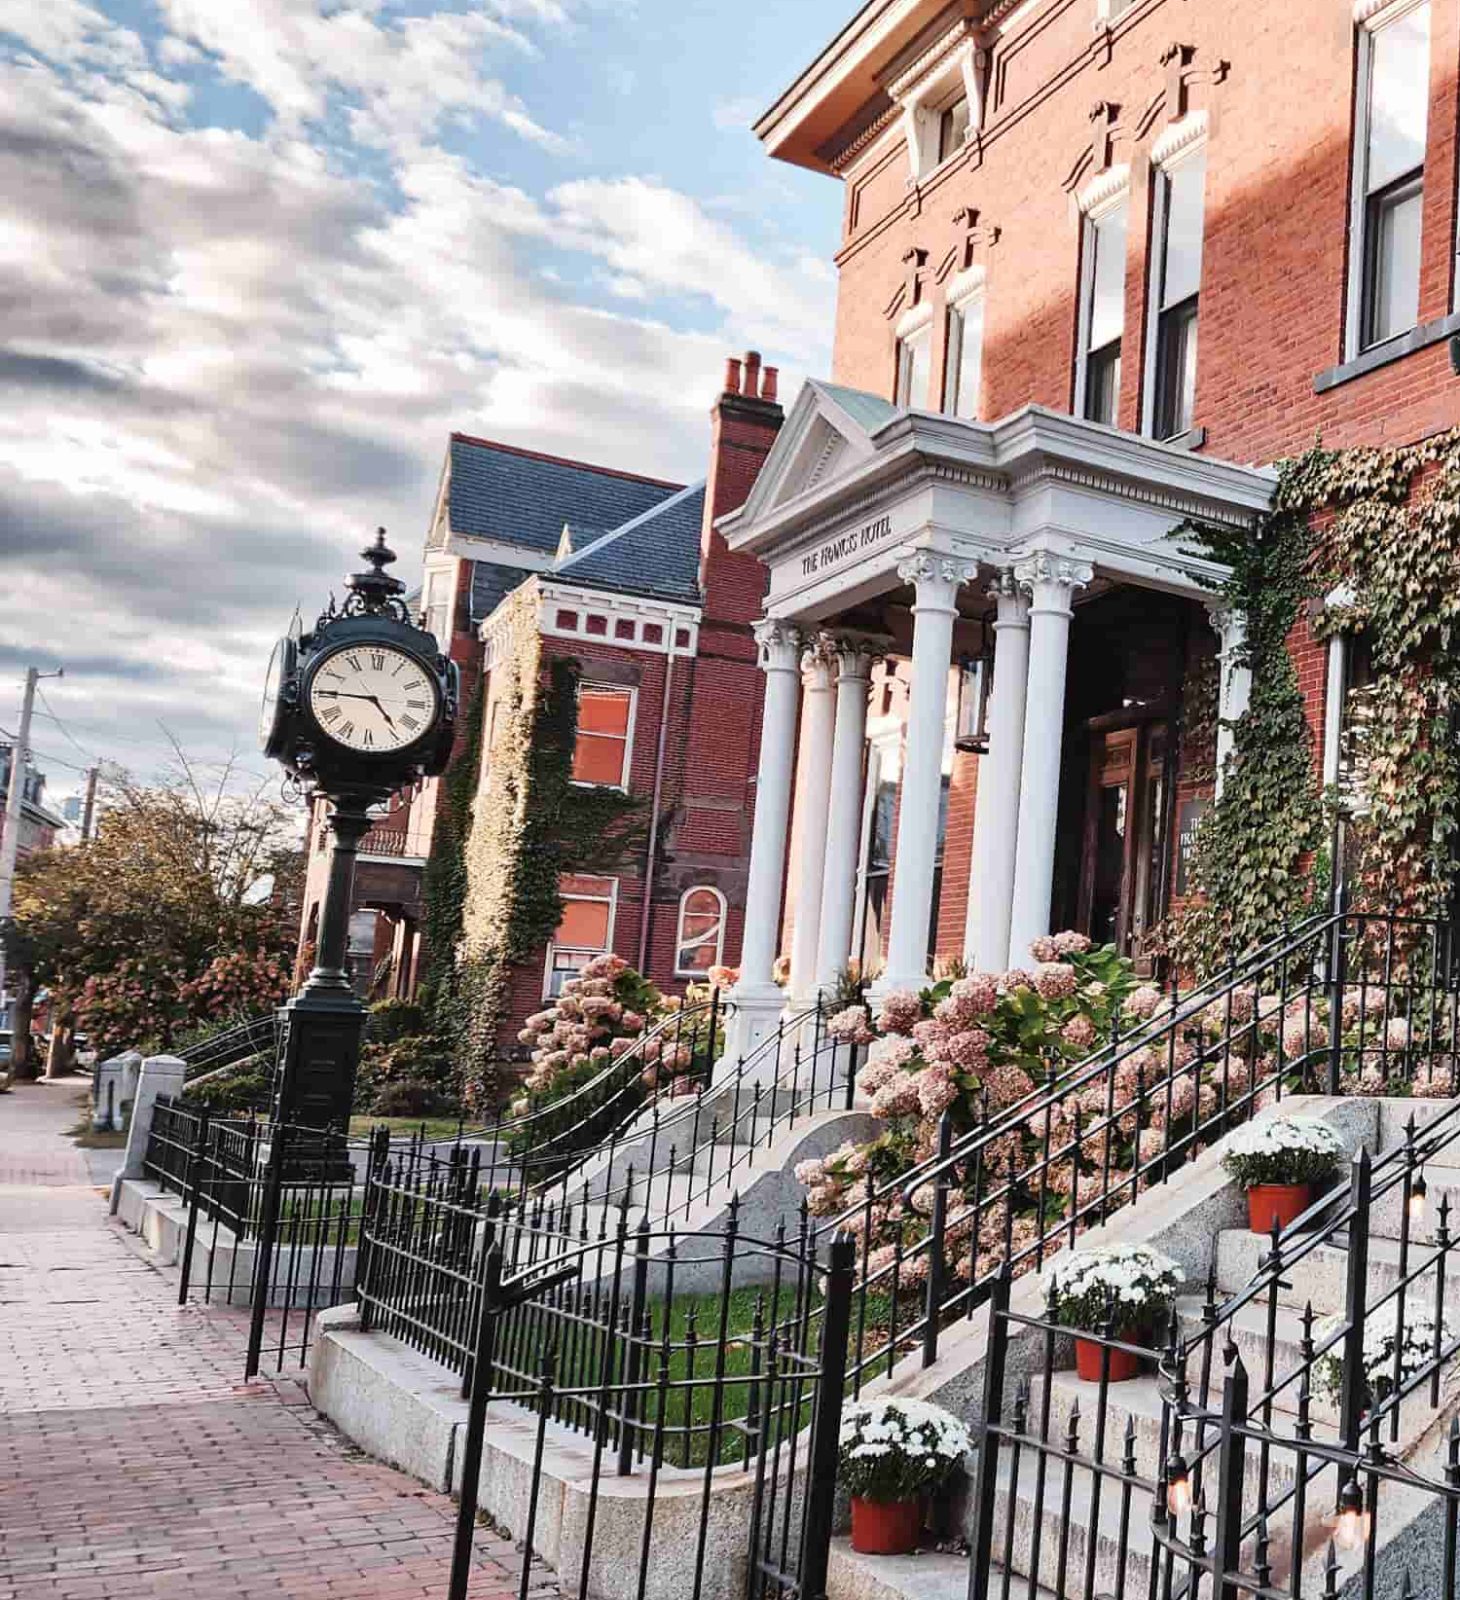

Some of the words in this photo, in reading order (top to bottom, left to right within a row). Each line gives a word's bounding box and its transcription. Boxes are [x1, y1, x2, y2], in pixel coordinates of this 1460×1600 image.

[802, 553, 819, 575] THE
[820, 533, 858, 567] FRANCIS
[860, 515, 892, 547] HOTEL
